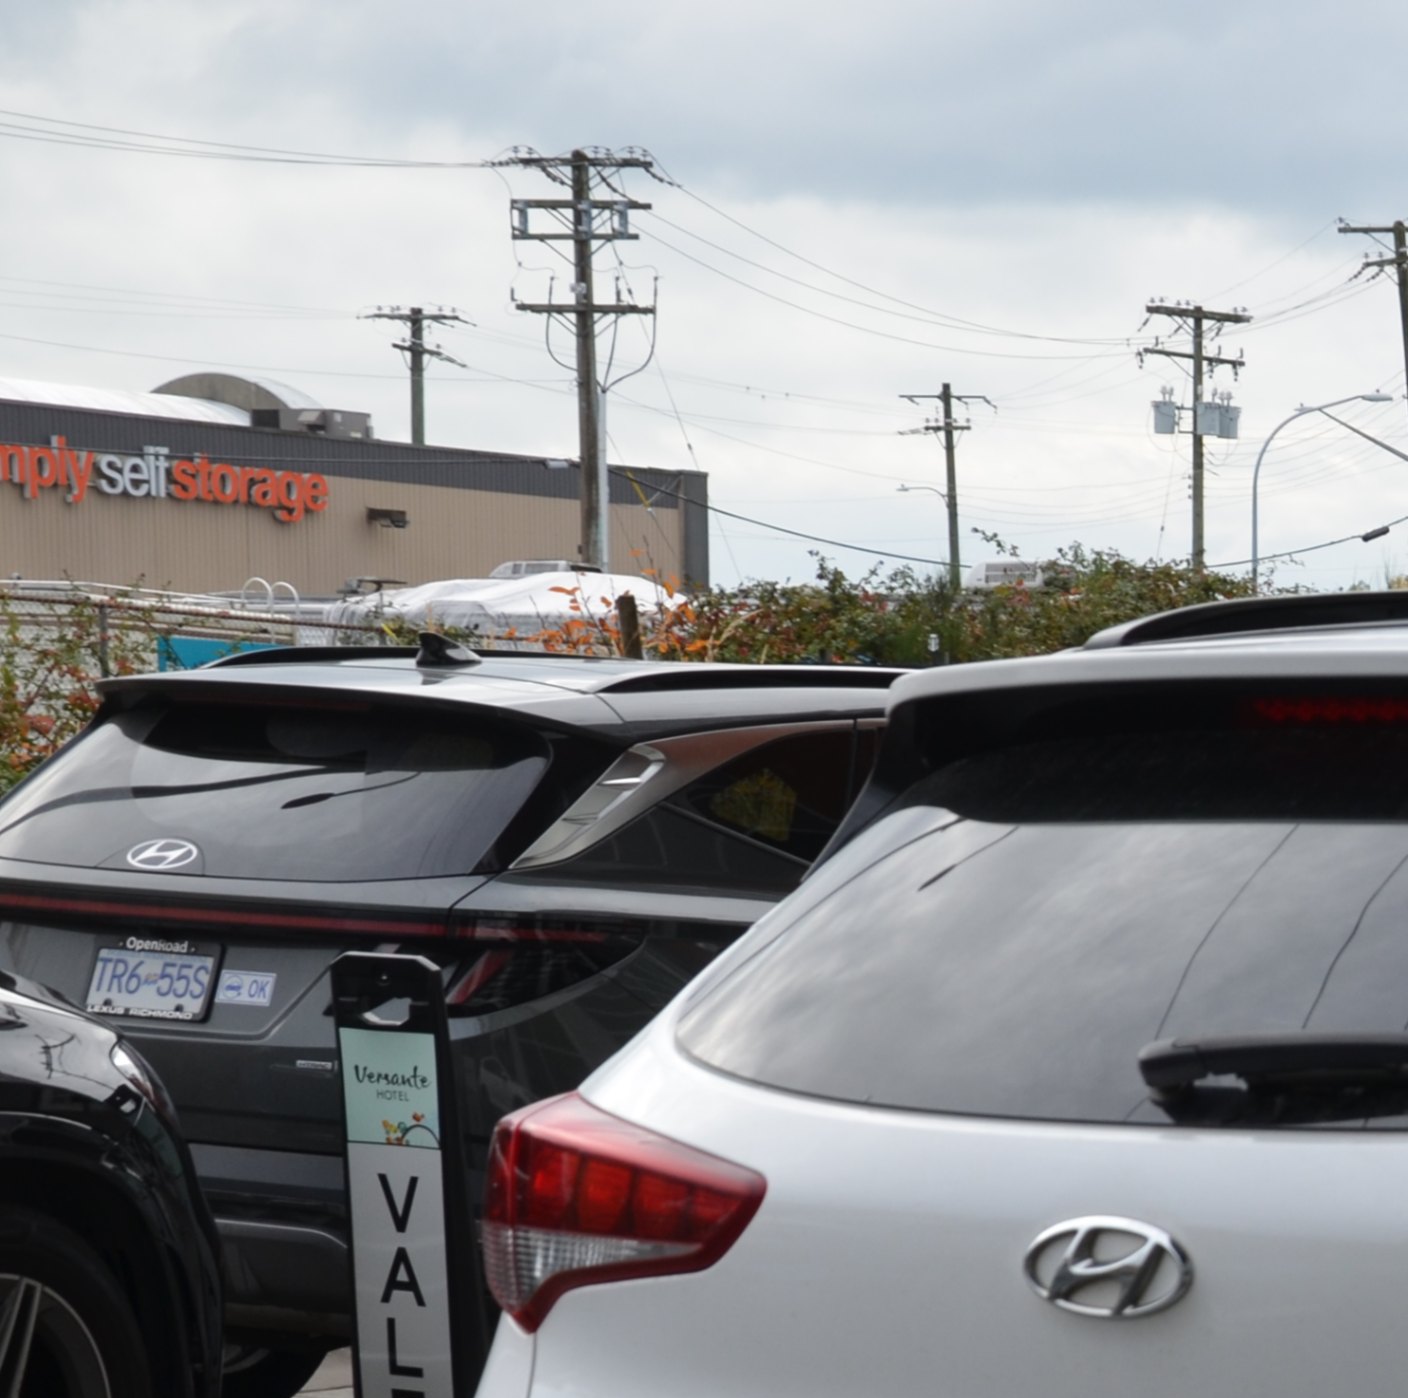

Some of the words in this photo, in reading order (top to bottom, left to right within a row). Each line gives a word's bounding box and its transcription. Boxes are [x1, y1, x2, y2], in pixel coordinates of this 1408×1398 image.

[98, 446, 169, 498] self
[169, 453, 329, 523] storage
[126, 936, 189, 953] OpenRoad
[96, 957, 145, 994] TR6
[156, 962, 209, 999] 55S
[248, 979, 270, 999] OK
[87, 1004, 125, 1015] LEXUS
[129, 1009, 193, 1020] RICHMOND
[354, 1064, 432, 1090] Versante
[376, 1090, 409, 1102] HOTEL
